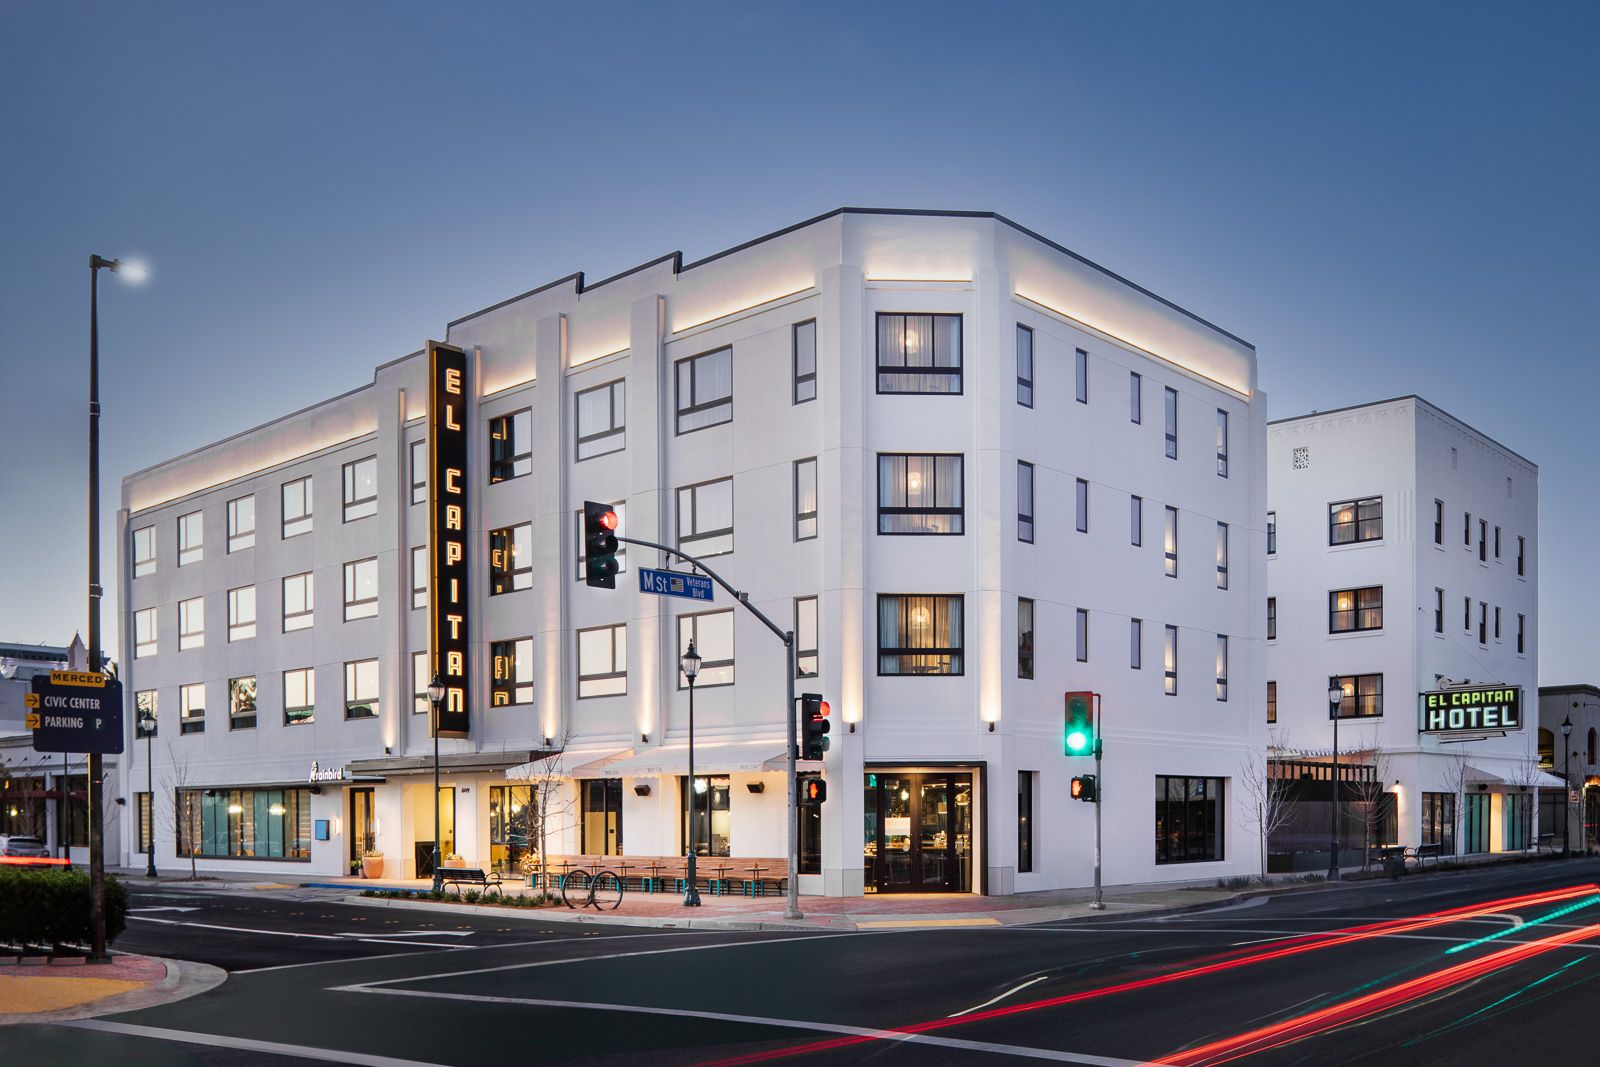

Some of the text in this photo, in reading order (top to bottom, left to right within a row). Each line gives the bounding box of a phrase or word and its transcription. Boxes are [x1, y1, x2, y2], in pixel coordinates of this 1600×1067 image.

[446, 367, 464, 713] EL CAPITAN
[643, 571, 668, 593] M St
[686, 576, 711, 589] Veterans
[692, 587, 705, 599] Blvd
[52, 673, 103, 684] MERCED
[44, 696, 101, 710] CIVIC CENTER
[1428, 690, 1514, 708] EL CAPITAN
[45, 716, 102, 729] PARKING P
[1429, 705, 1518, 730] HOTEL
